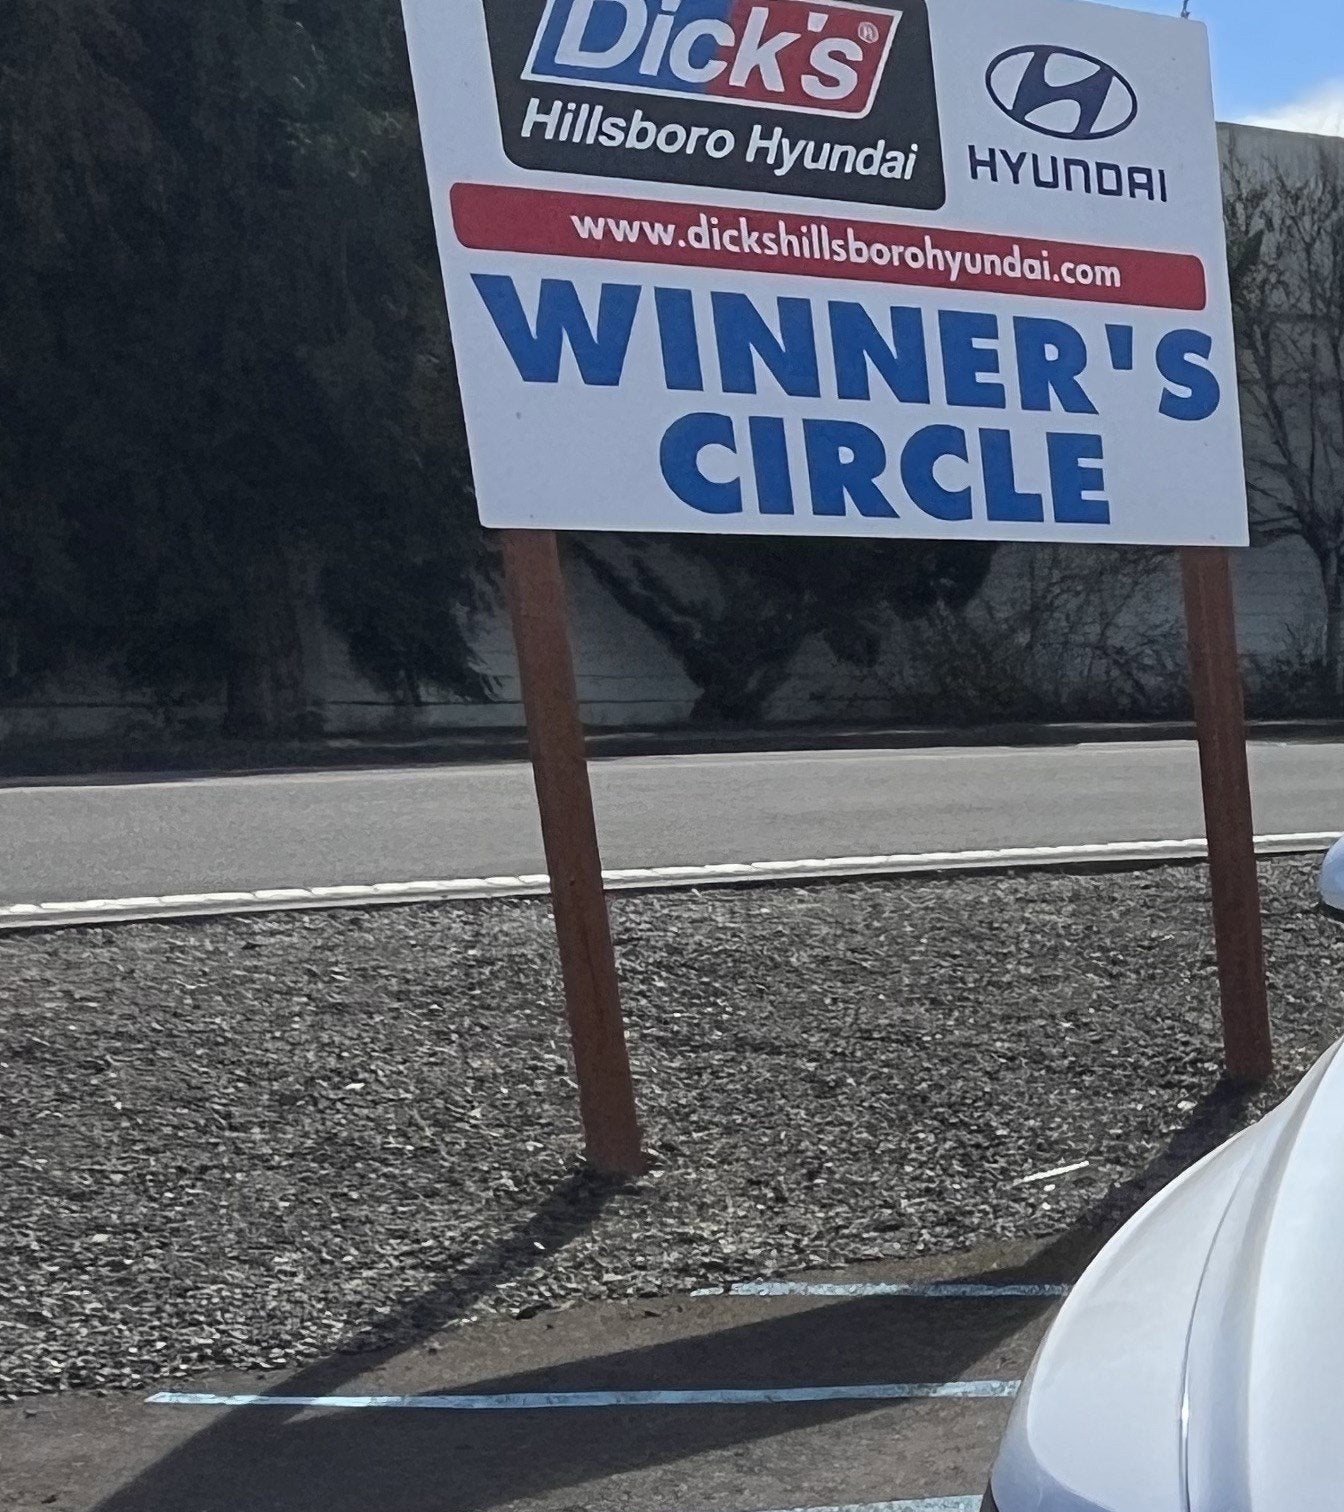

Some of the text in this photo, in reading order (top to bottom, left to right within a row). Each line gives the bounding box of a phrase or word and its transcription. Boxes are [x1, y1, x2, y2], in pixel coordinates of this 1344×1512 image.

[554, 0, 863, 100] Dick's
[521, 97, 919, 180] Hillsboro Hyundai
[968, 144, 1167, 202] HYUNDAI
[570, 210, 1122, 289] www.dickshillsborohyundai.com
[471, 273, 1221, 421] WINNER'S
[660, 412, 1110, 525] CIRCLE
